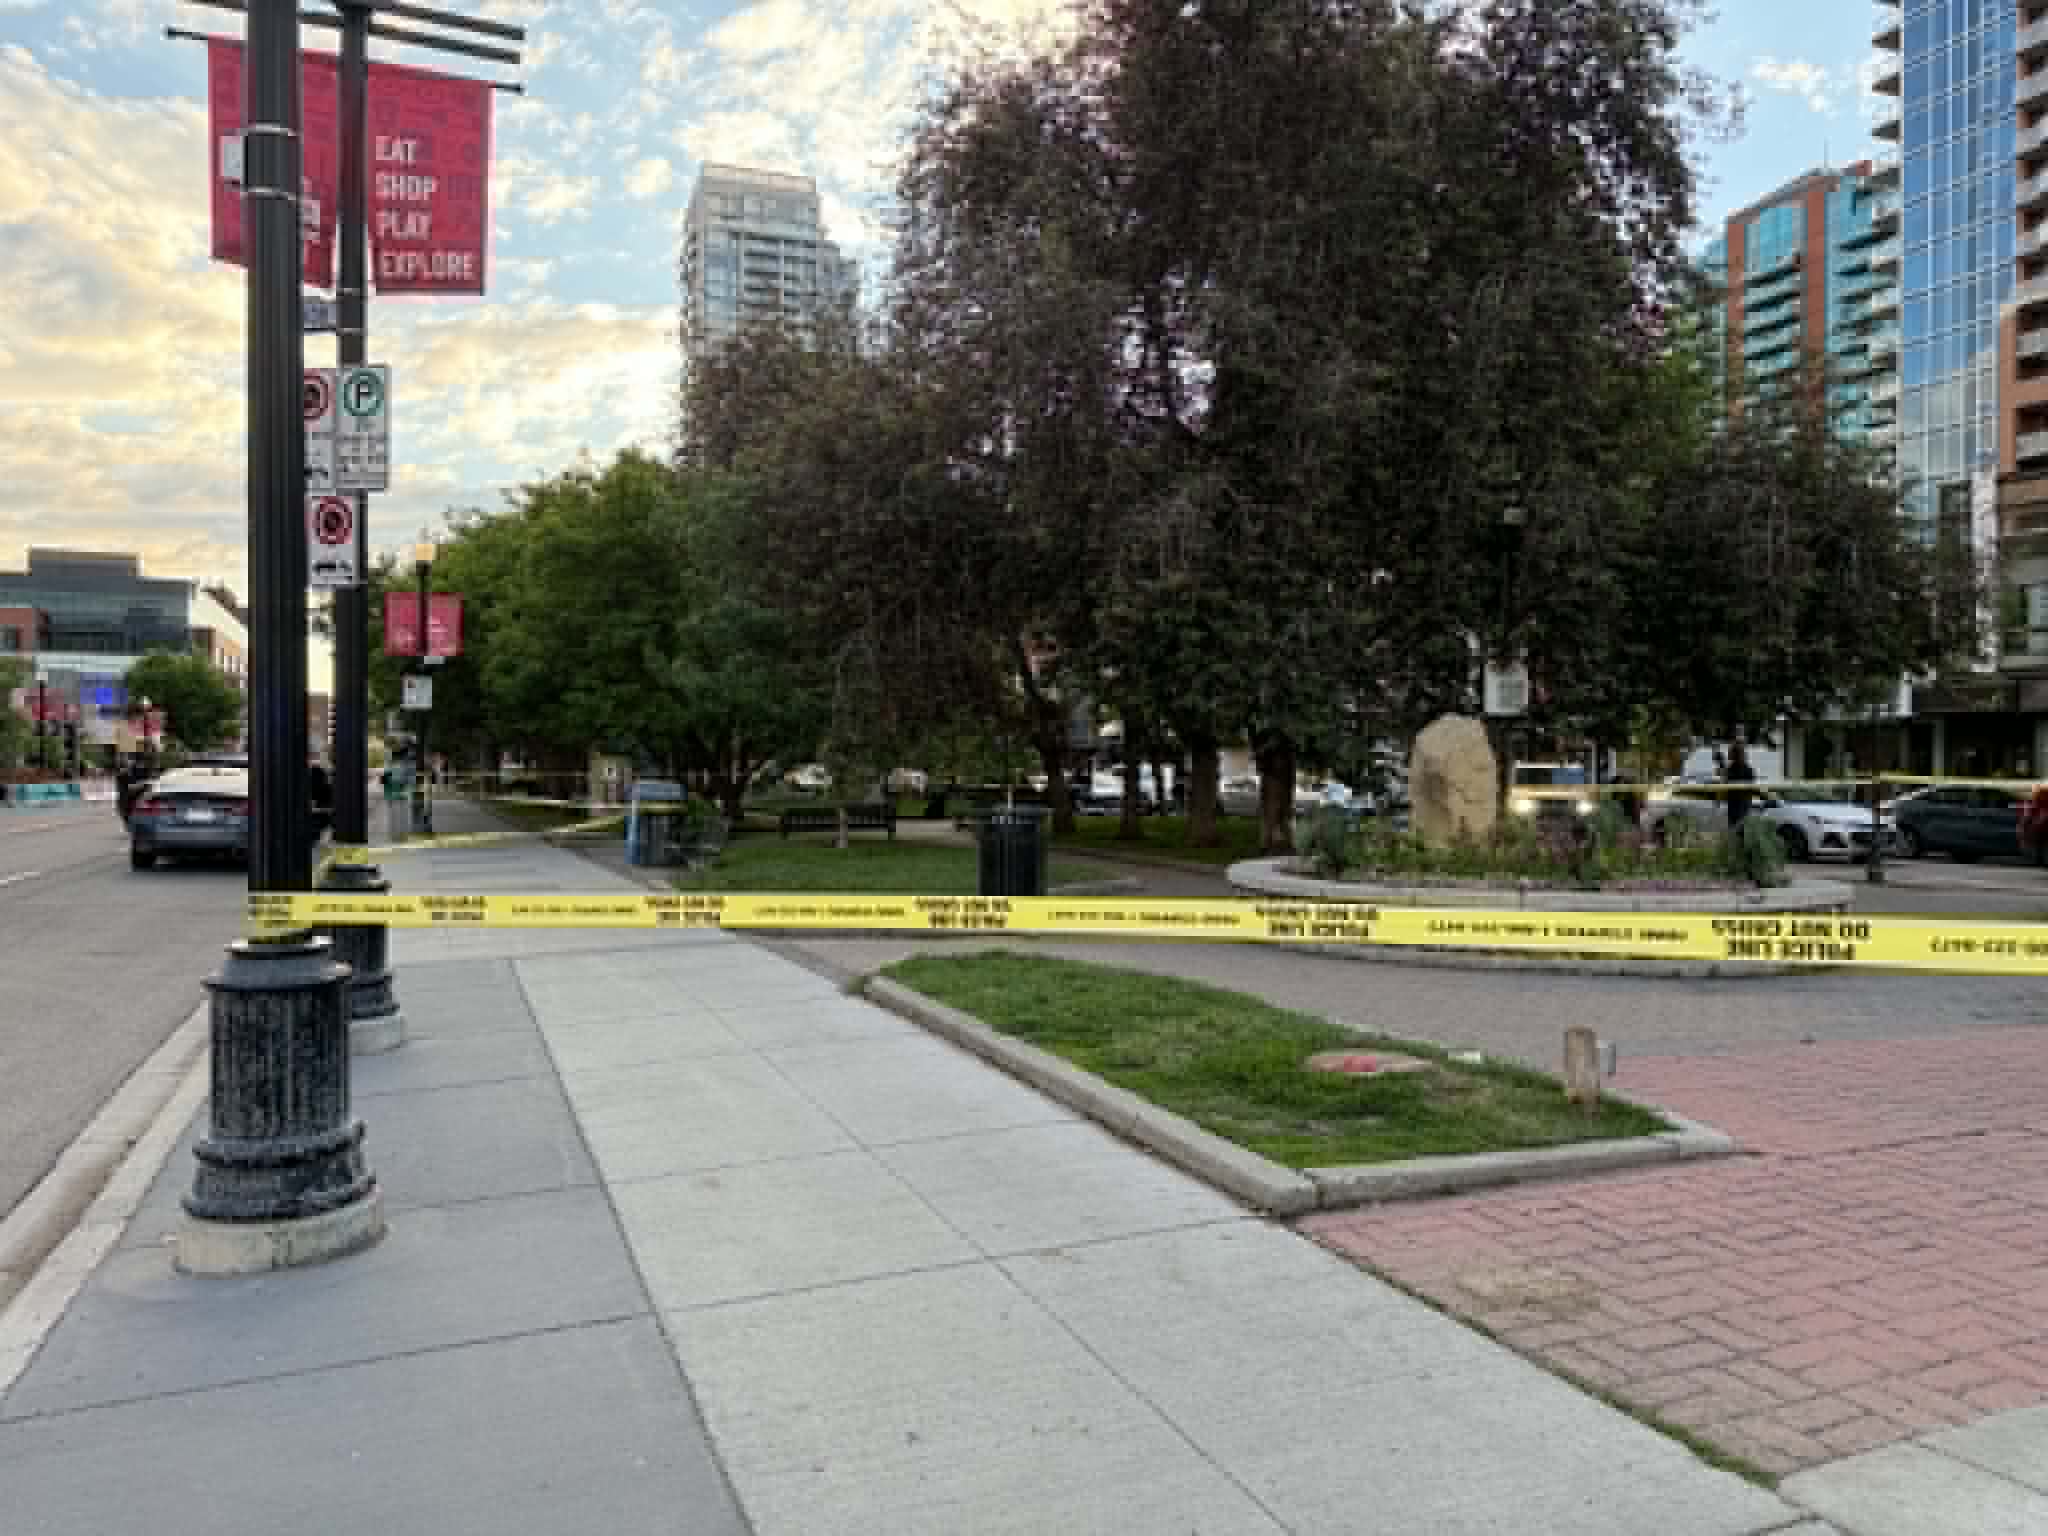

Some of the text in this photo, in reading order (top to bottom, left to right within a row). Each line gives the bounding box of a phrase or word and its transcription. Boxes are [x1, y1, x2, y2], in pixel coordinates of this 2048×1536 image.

[374, 135, 418, 163] EAT
[374, 173, 437, 202] SHOP
[375, 210, 433, 240] PLAY
[379, 252, 475, 281] EXPLORE
[1711, 919, 1782, 938] CROSS
[1789, 919, 1833, 939] NOT
[1838, 920, 1871, 941] DO
[1726, 939, 1855, 961] POLICE LINE
